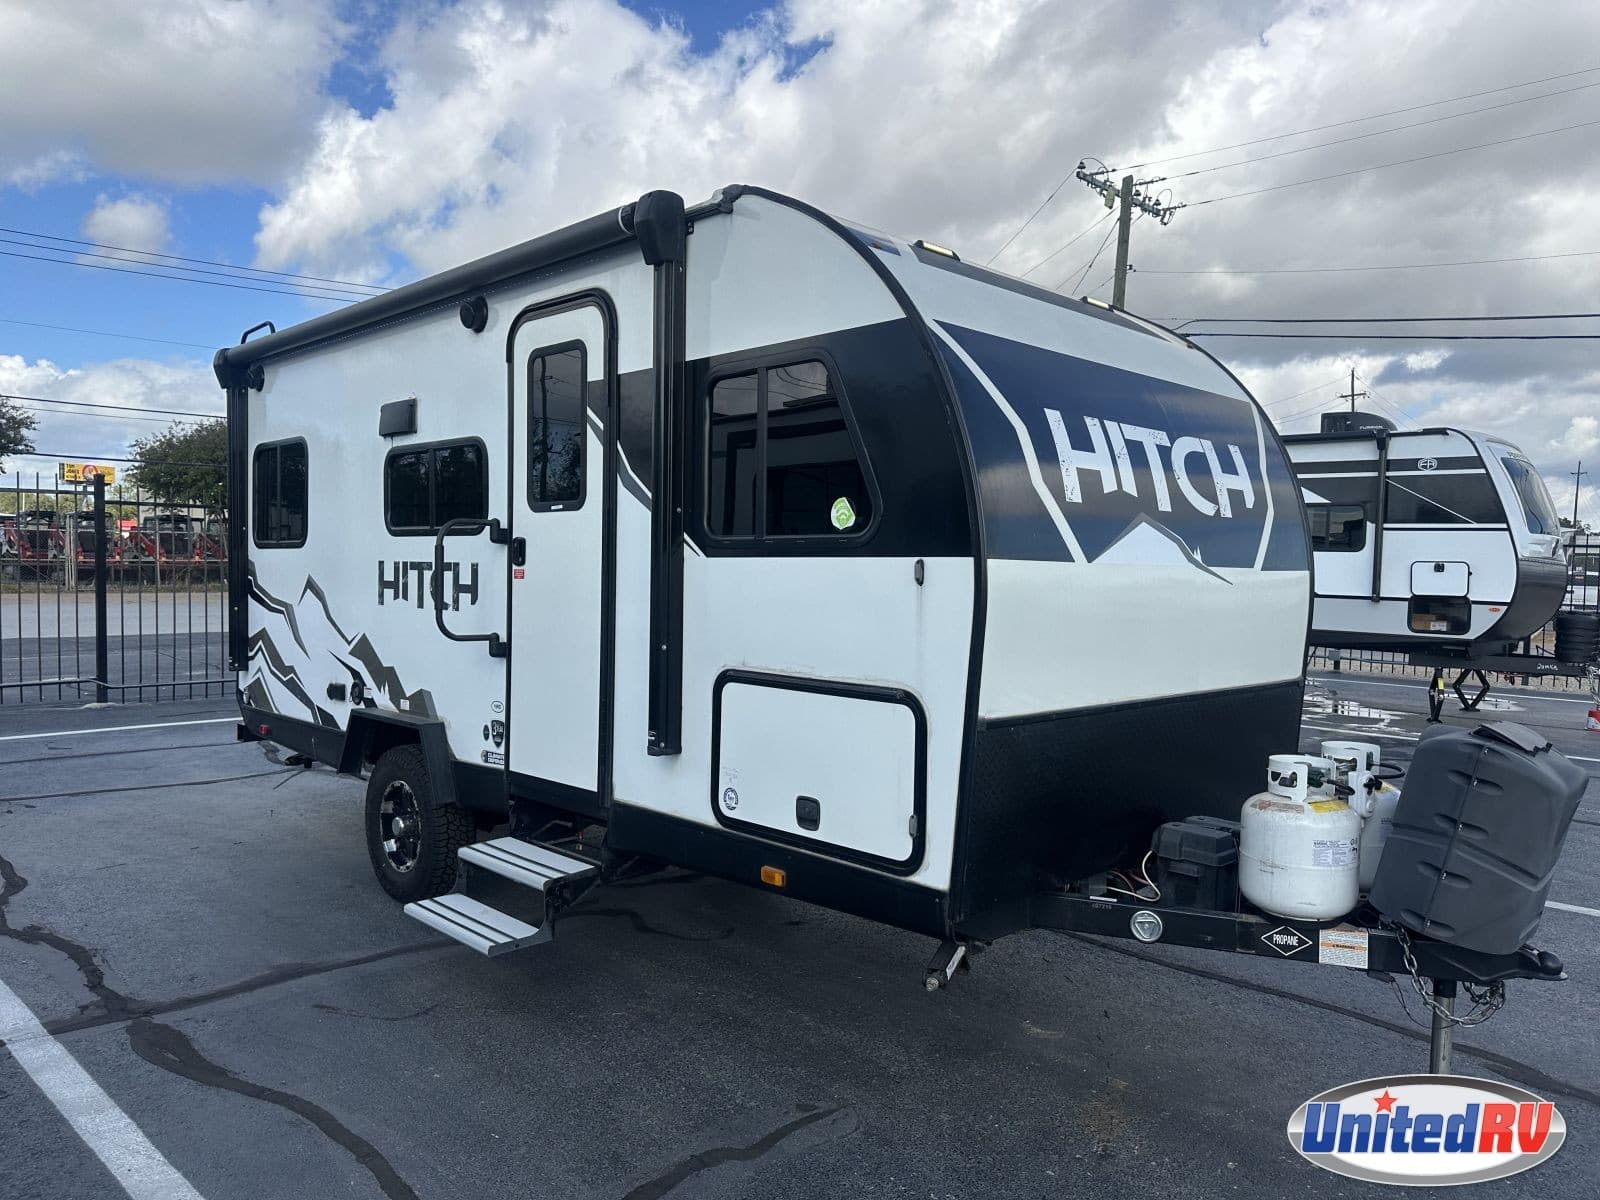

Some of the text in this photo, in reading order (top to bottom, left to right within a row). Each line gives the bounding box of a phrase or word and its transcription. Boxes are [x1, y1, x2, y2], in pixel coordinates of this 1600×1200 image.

[1043, 408, 1255, 518] HITCH
[378, 560, 479, 611] HITCH
[1273, 934, 1299, 946] PROPANE
